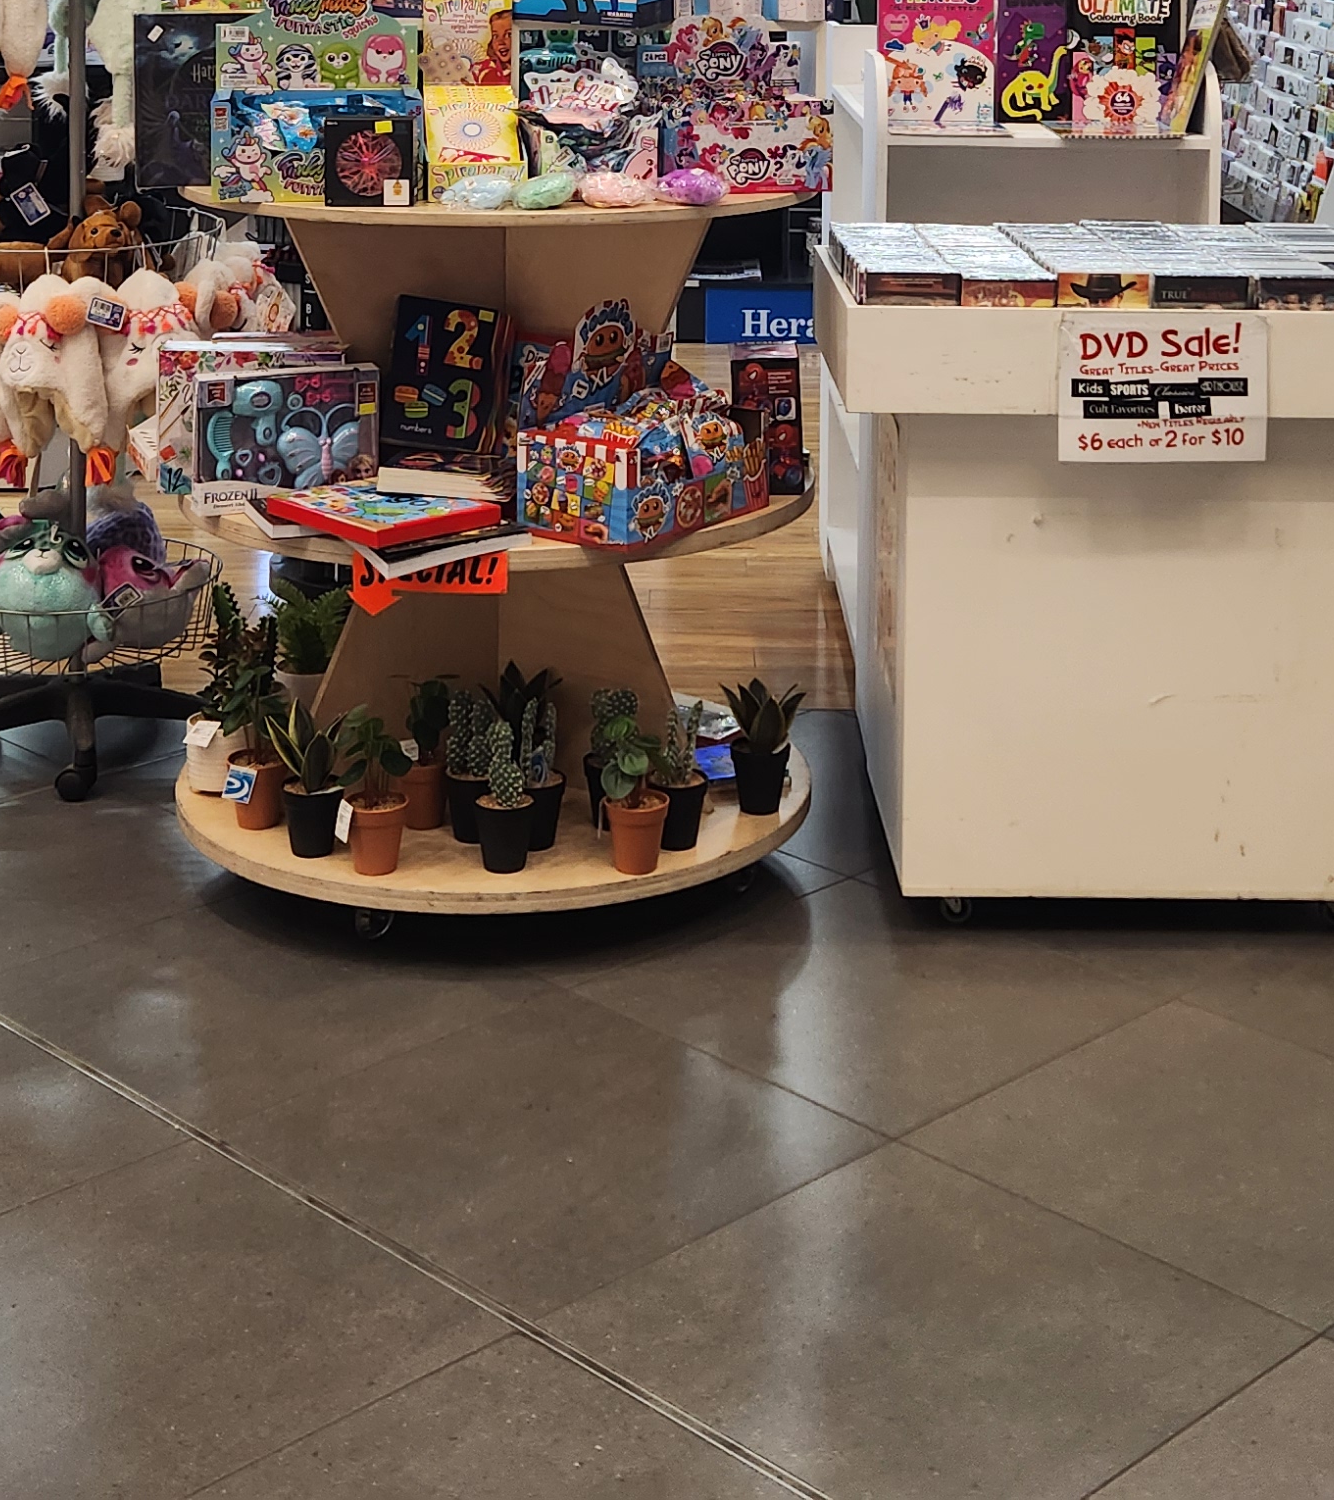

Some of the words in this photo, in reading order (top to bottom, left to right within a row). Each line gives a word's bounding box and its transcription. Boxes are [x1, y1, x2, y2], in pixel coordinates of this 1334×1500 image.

[1089, 13, 1136, 25] Colouring
[1137, 13, 1164, 24] Book
[696, 54, 744, 81] PONY
[1115, 91, 1131, 102] 64
[727, 160, 770, 185] PONY
[1161, 289, 1188, 300] TRUE
[442, 309, 484, 370] 2
[1079, 331, 1149, 361] DVD
[1161, 322, 1242, 358] Sale!
[590, 366, 613, 393] XL
[1077, 382, 1104, 395] Kids
[1110, 384, 1149, 396] SPORTS
[445, 378, 482, 440] 3
[1089, 404, 1109, 415] Cult
[1110, 404, 1156, 415] Favorites
[399, 423, 433, 434] numbers
[1077, 432, 1103, 451] $6
[1106, 434, 1143, 450] each
[1149, 438, 1162, 447] or
[1165, 430, 1177, 448] 2
[1181, 432, 1206, 446] for
[1211, 427, 1244, 446] $10
[204, 490, 250, 505] FROZEN
[642, 526, 659, 543] XL
[360, 557, 499, 587] SCIAL!
